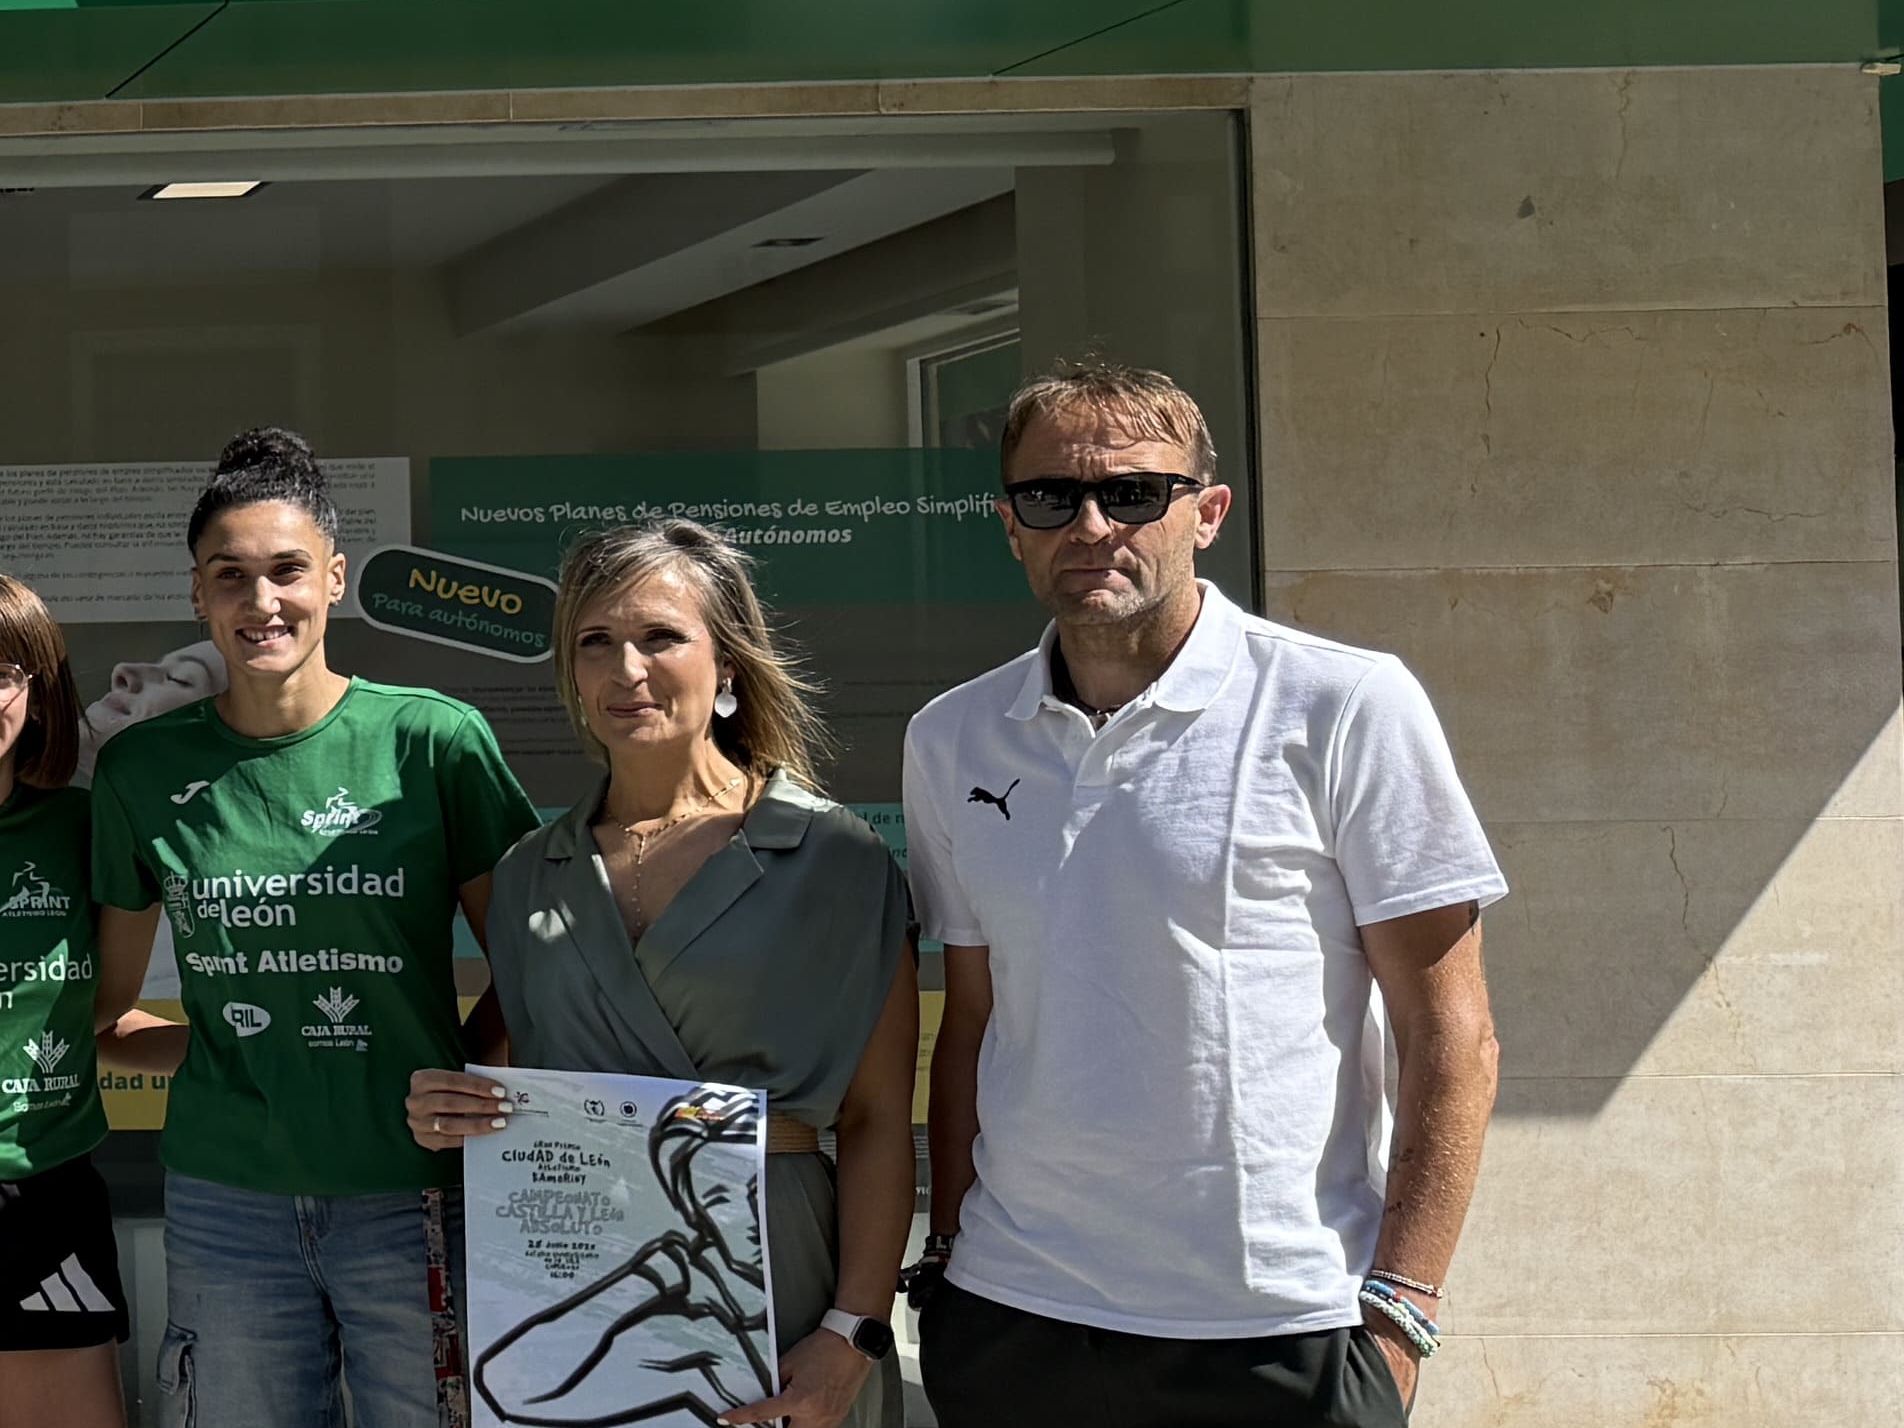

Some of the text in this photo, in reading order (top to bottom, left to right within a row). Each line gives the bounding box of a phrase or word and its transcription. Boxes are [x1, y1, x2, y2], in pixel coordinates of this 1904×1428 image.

[461, 492, 997, 522] Nuevos Planes de Pensiones de Empleo Simplifi
[409, 568, 523, 614] Nuevo
[371, 593, 546, 649] Para autónomos
[192, 865, 404, 900] universidad
[197, 896, 296, 929] de león
[257, 948, 404, 975] Atletismo
[1, 1073, 81, 1094] CAJA RURAL
[98, 1072, 144, 1091] dad
[559, 1152, 575, 1164] de
